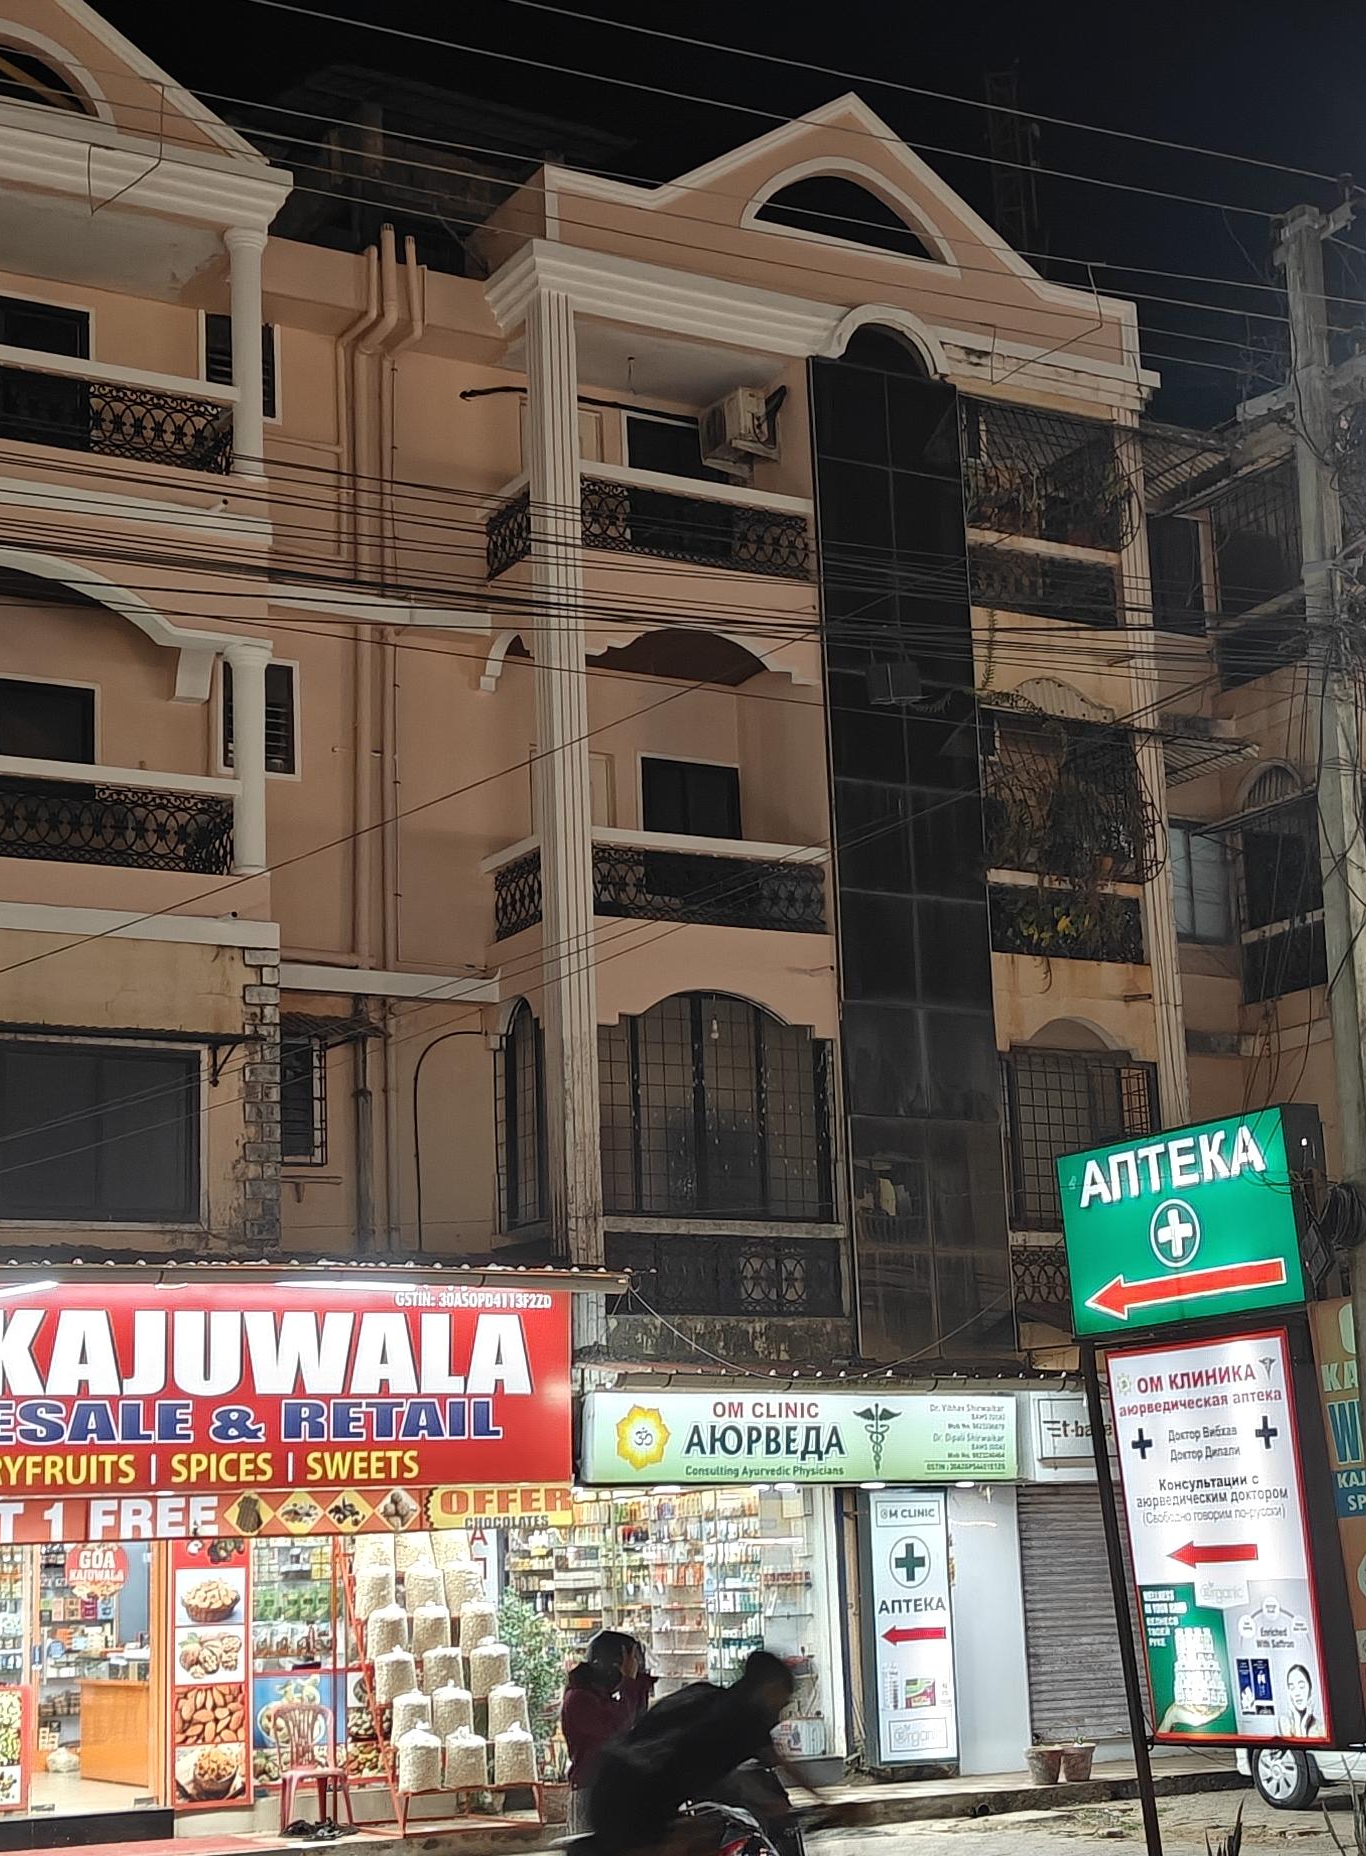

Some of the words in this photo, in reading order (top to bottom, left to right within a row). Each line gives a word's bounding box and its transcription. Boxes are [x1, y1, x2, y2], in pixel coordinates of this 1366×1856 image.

[1079, 1125, 1266, 1208] АПТЕКА
[1137, 1375, 1163, 1394] ОМ
[1169, 1364, 1257, 1390] КЛИНИКА
[713, 1402, 744, 1418] OM
[752, 1402, 819, 1418] CLINIC
[1119, 1393, 1228, 1417] аюрведическая
[1232, 1389, 1282, 1404] аптека
[209, 1405, 266, 1443] &
[280, 1398, 503, 1444] RETAIL
[685, 1424, 846, 1461] АЮРВЕДА
[170, 1451, 273, 1484] SPICES
[306, 1449, 419, 1481] SWEETS
[685, 1465, 739, 1478] Consulting
[741, 1465, 789, 1478] Ayurvedic
[792, 1465, 844, 1478] Physicians
[1158, 1475, 1247, 1492] Консультации
[440, 1488, 573, 1515] OFFER
[1230, 1487, 1288, 1503] доктором
[43, 1503, 64, 1541] 1
[89, 1496, 219, 1540] FREE
[464, 1514, 549, 1530] CHOCOLATES
[900, 1508, 935, 1519] CLINIC
[78, 1550, 116, 1569] GOA
[68, 1568, 125, 1582] KAJUWALA
[878, 1596, 946, 1615] АПТЕКА
